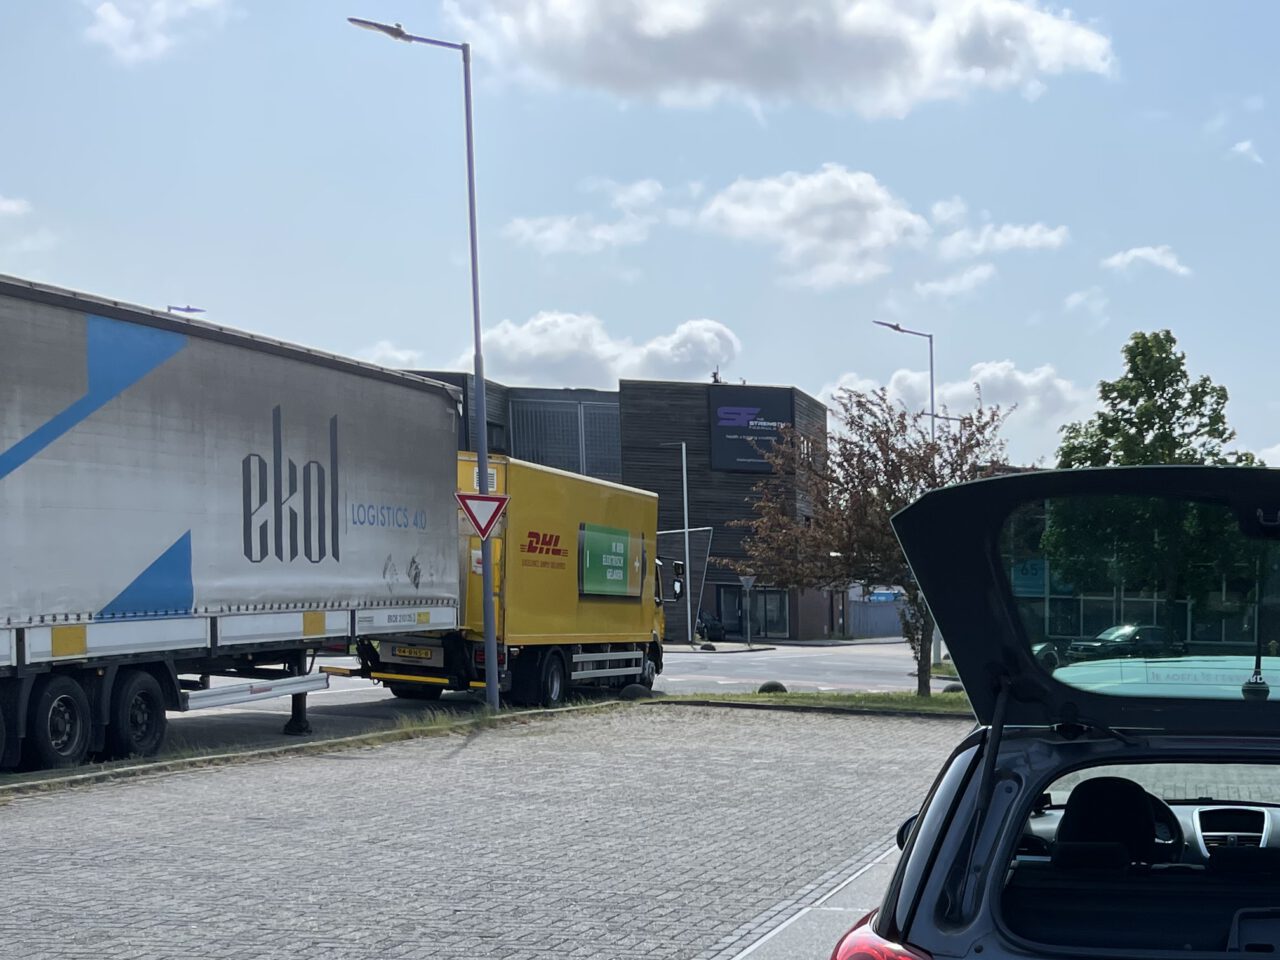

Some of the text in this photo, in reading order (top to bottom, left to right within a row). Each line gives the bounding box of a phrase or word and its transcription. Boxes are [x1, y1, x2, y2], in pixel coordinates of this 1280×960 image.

[242, 404, 340, 563] ekol
[351, 503, 409, 529] LOGISTICS
[526, 531, 562, 556] DHL
